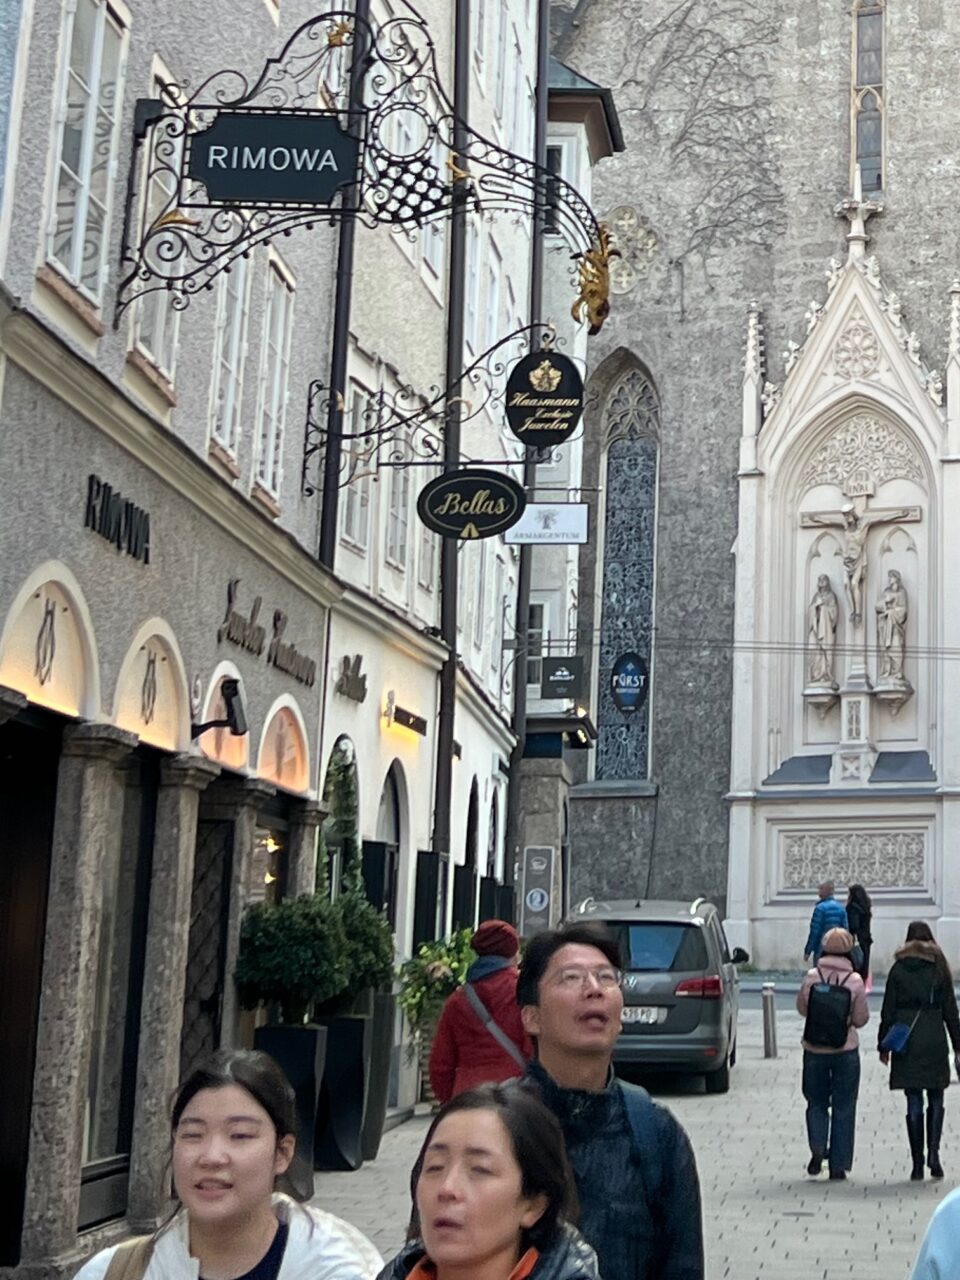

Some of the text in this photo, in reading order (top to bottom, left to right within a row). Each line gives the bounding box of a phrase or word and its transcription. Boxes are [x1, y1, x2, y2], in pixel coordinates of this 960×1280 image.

[208, 145, 338, 172] RIMOWA
[509, 392, 580, 407] Haasmann
[517, 417, 569, 433] Juwelen
[434, 489, 509, 515] Bellas
